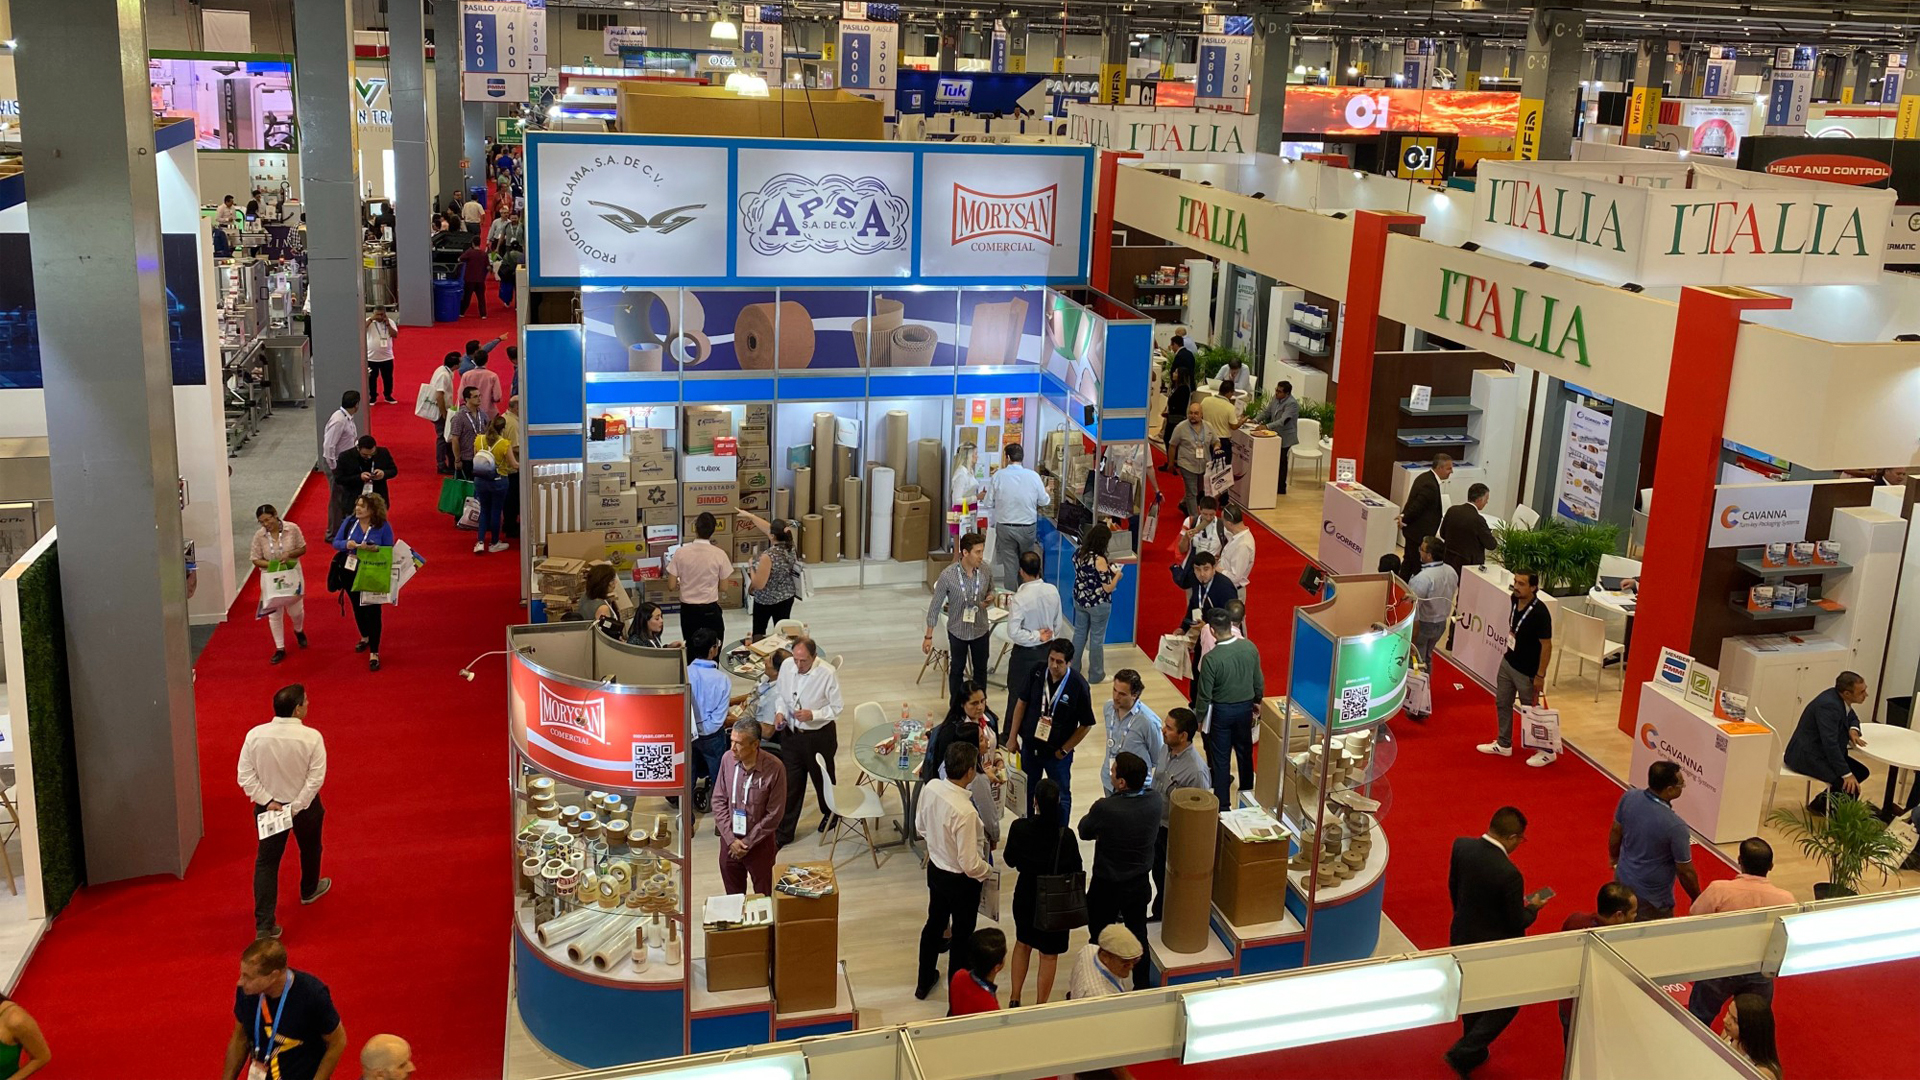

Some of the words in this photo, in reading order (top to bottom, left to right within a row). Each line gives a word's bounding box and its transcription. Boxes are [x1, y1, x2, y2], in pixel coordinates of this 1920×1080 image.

[941, 83, 967, 97] Tuk
[1046, 79, 1099, 94] PAVISA
[1070, 112, 1111, 150] ITALIA
[1129, 122, 1245, 154] ITALIA
[594, 155, 619, 168] S.A.
[624, 155, 640, 169] DE
[1770, 165, 1801, 174] HEAT
[1803, 165, 1829, 175] AND
[1832, 167, 1889, 176] CONTROL
[560, 165, 594, 206] GLAMA,
[642, 164, 663, 188] C.V.
[766, 196, 891, 237] APSA
[802, 220, 821, 229] S.A.
[823, 221, 837, 230] DE
[840, 221, 858, 230] C.V.
[959, 195, 1052, 237] MORYSAN
[1175, 195, 1250, 254] ITALIA
[1485, 178, 1626, 253] ITALIA
[560, 210, 617, 264] PRODUCTOS
[1664, 201, 1869, 257] ITALIA
[971, 242, 1035, 252] COMERCIAL
[1434, 267, 1591, 368] ITALIA
[696, 495, 728, 505] BIMBO
[1742, 509, 1788, 520] CAVANNA
[1665, 650, 1690, 663] MEMBER
[1662, 663, 1685, 677] PMMI
[542, 690, 601, 736] MORYSAN
[550, 727, 592, 746] COMERCIAL
[1660, 740, 1703, 776] CAVANNA
